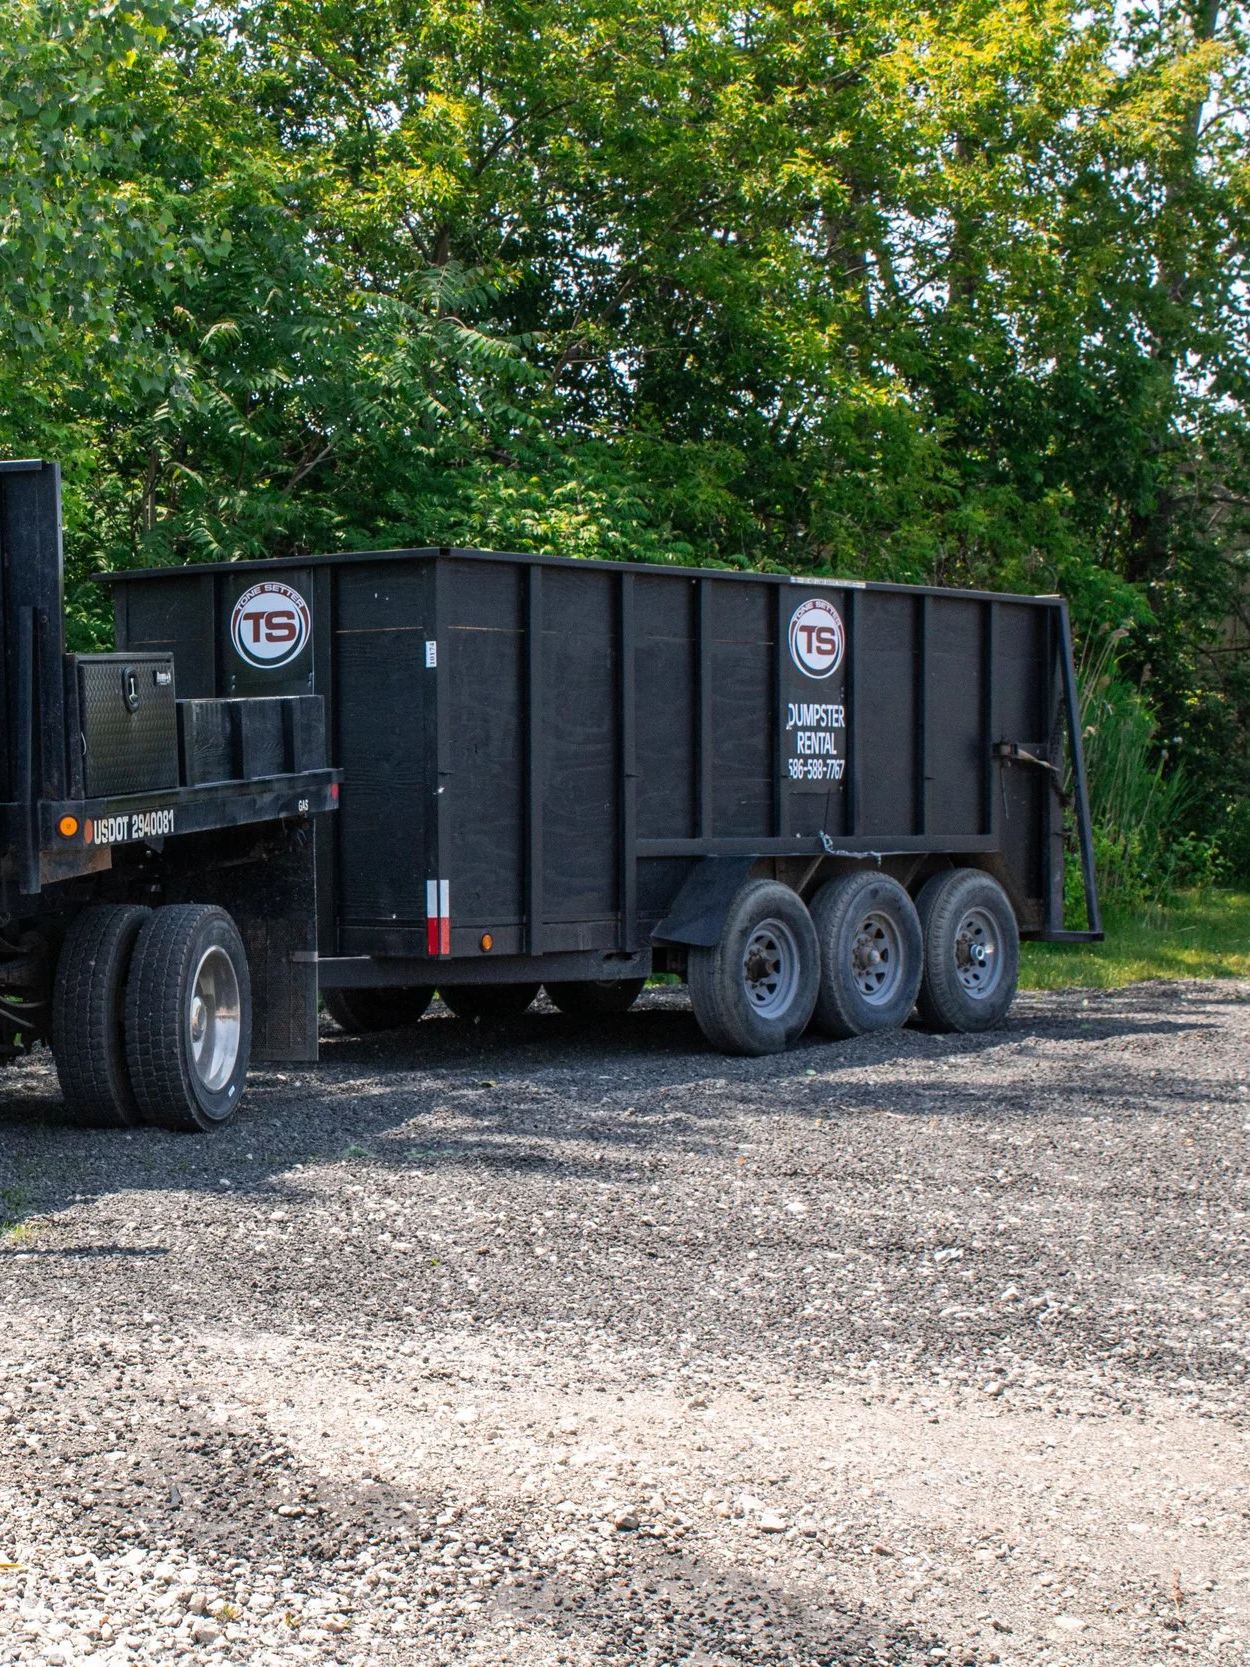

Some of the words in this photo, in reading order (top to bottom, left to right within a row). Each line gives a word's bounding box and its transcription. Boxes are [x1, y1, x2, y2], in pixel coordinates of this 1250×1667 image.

[236, 586, 261, 611] TONE
[264, 584, 304, 609] SETTER
[243, 610, 297, 643] TS
[798, 625, 836, 656] TS
[787, 703, 845, 728] DUMPSTER
[797, 731, 837, 755] RENTAL
[788, 758, 845, 779] 586-588-7767
[298, 799, 309, 812] GAS
[93, 815, 129, 845] USDOT
[132, 809, 174, 839] 2940081
